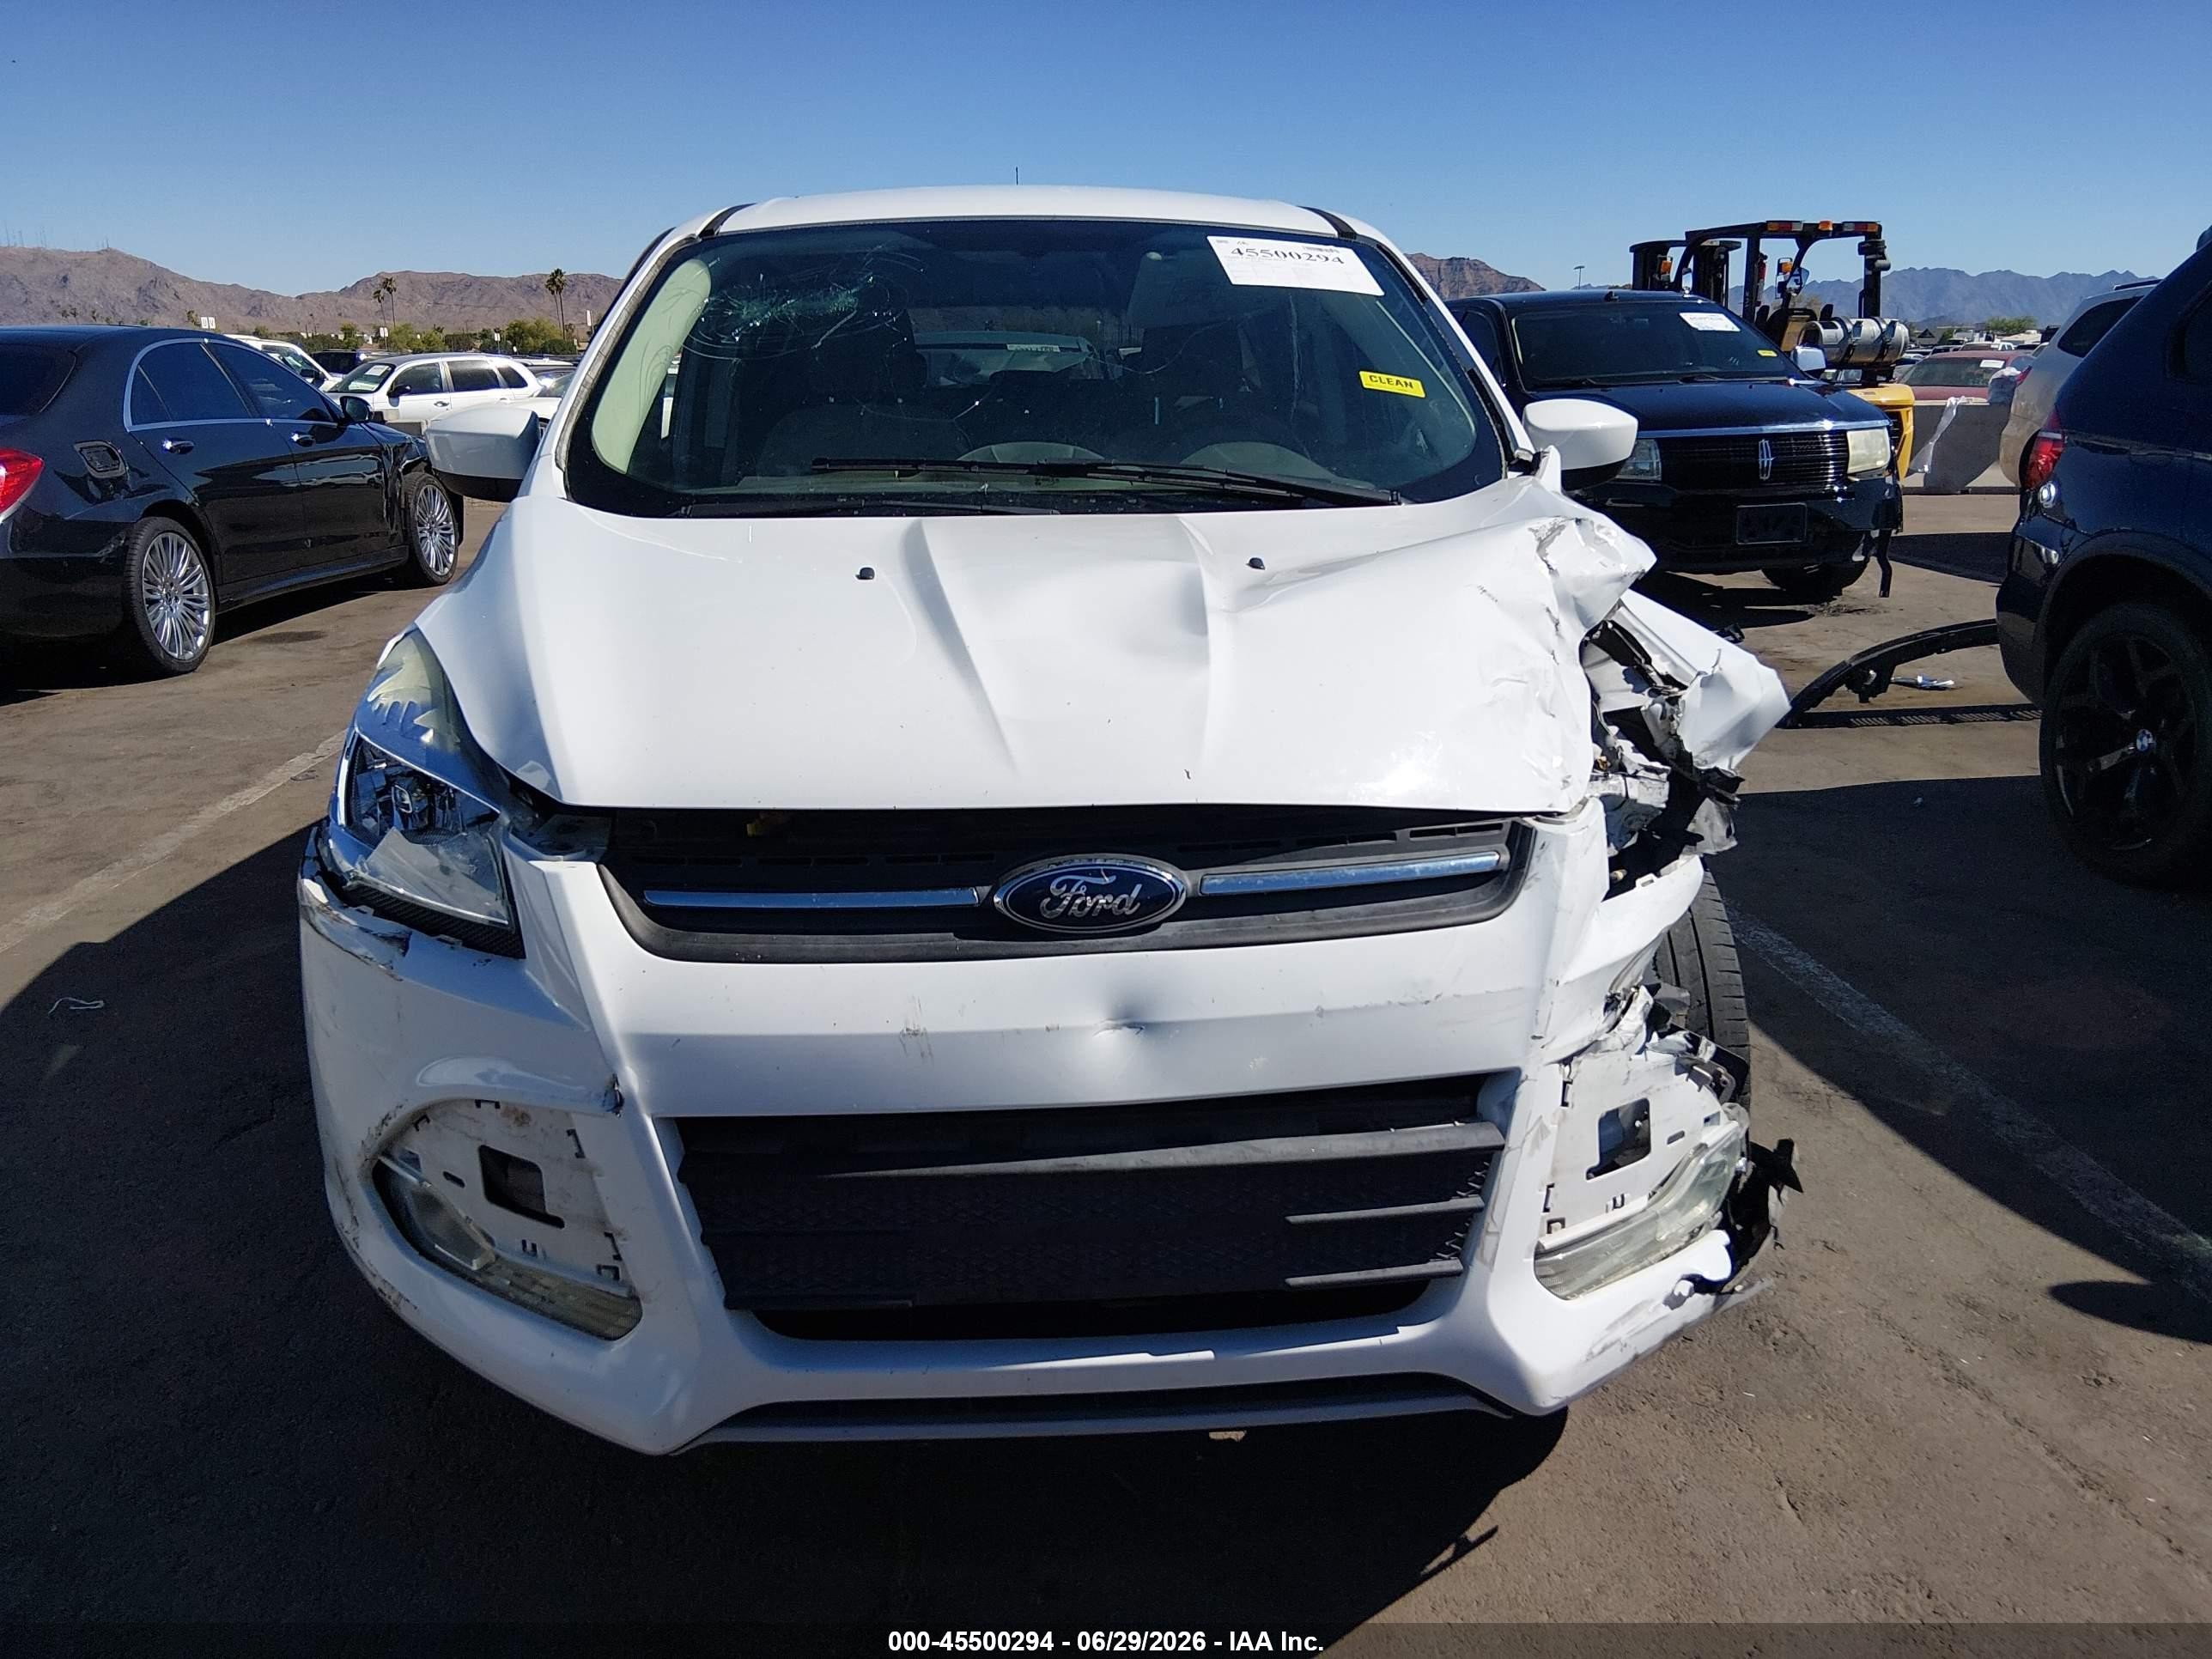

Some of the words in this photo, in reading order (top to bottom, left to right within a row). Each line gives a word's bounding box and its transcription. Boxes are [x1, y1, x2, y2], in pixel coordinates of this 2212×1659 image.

[1231, 246, 1345, 264] 45500294
[1369, 374, 1414, 389] CLEAN
[1039, 875, 1143, 919] Ford
